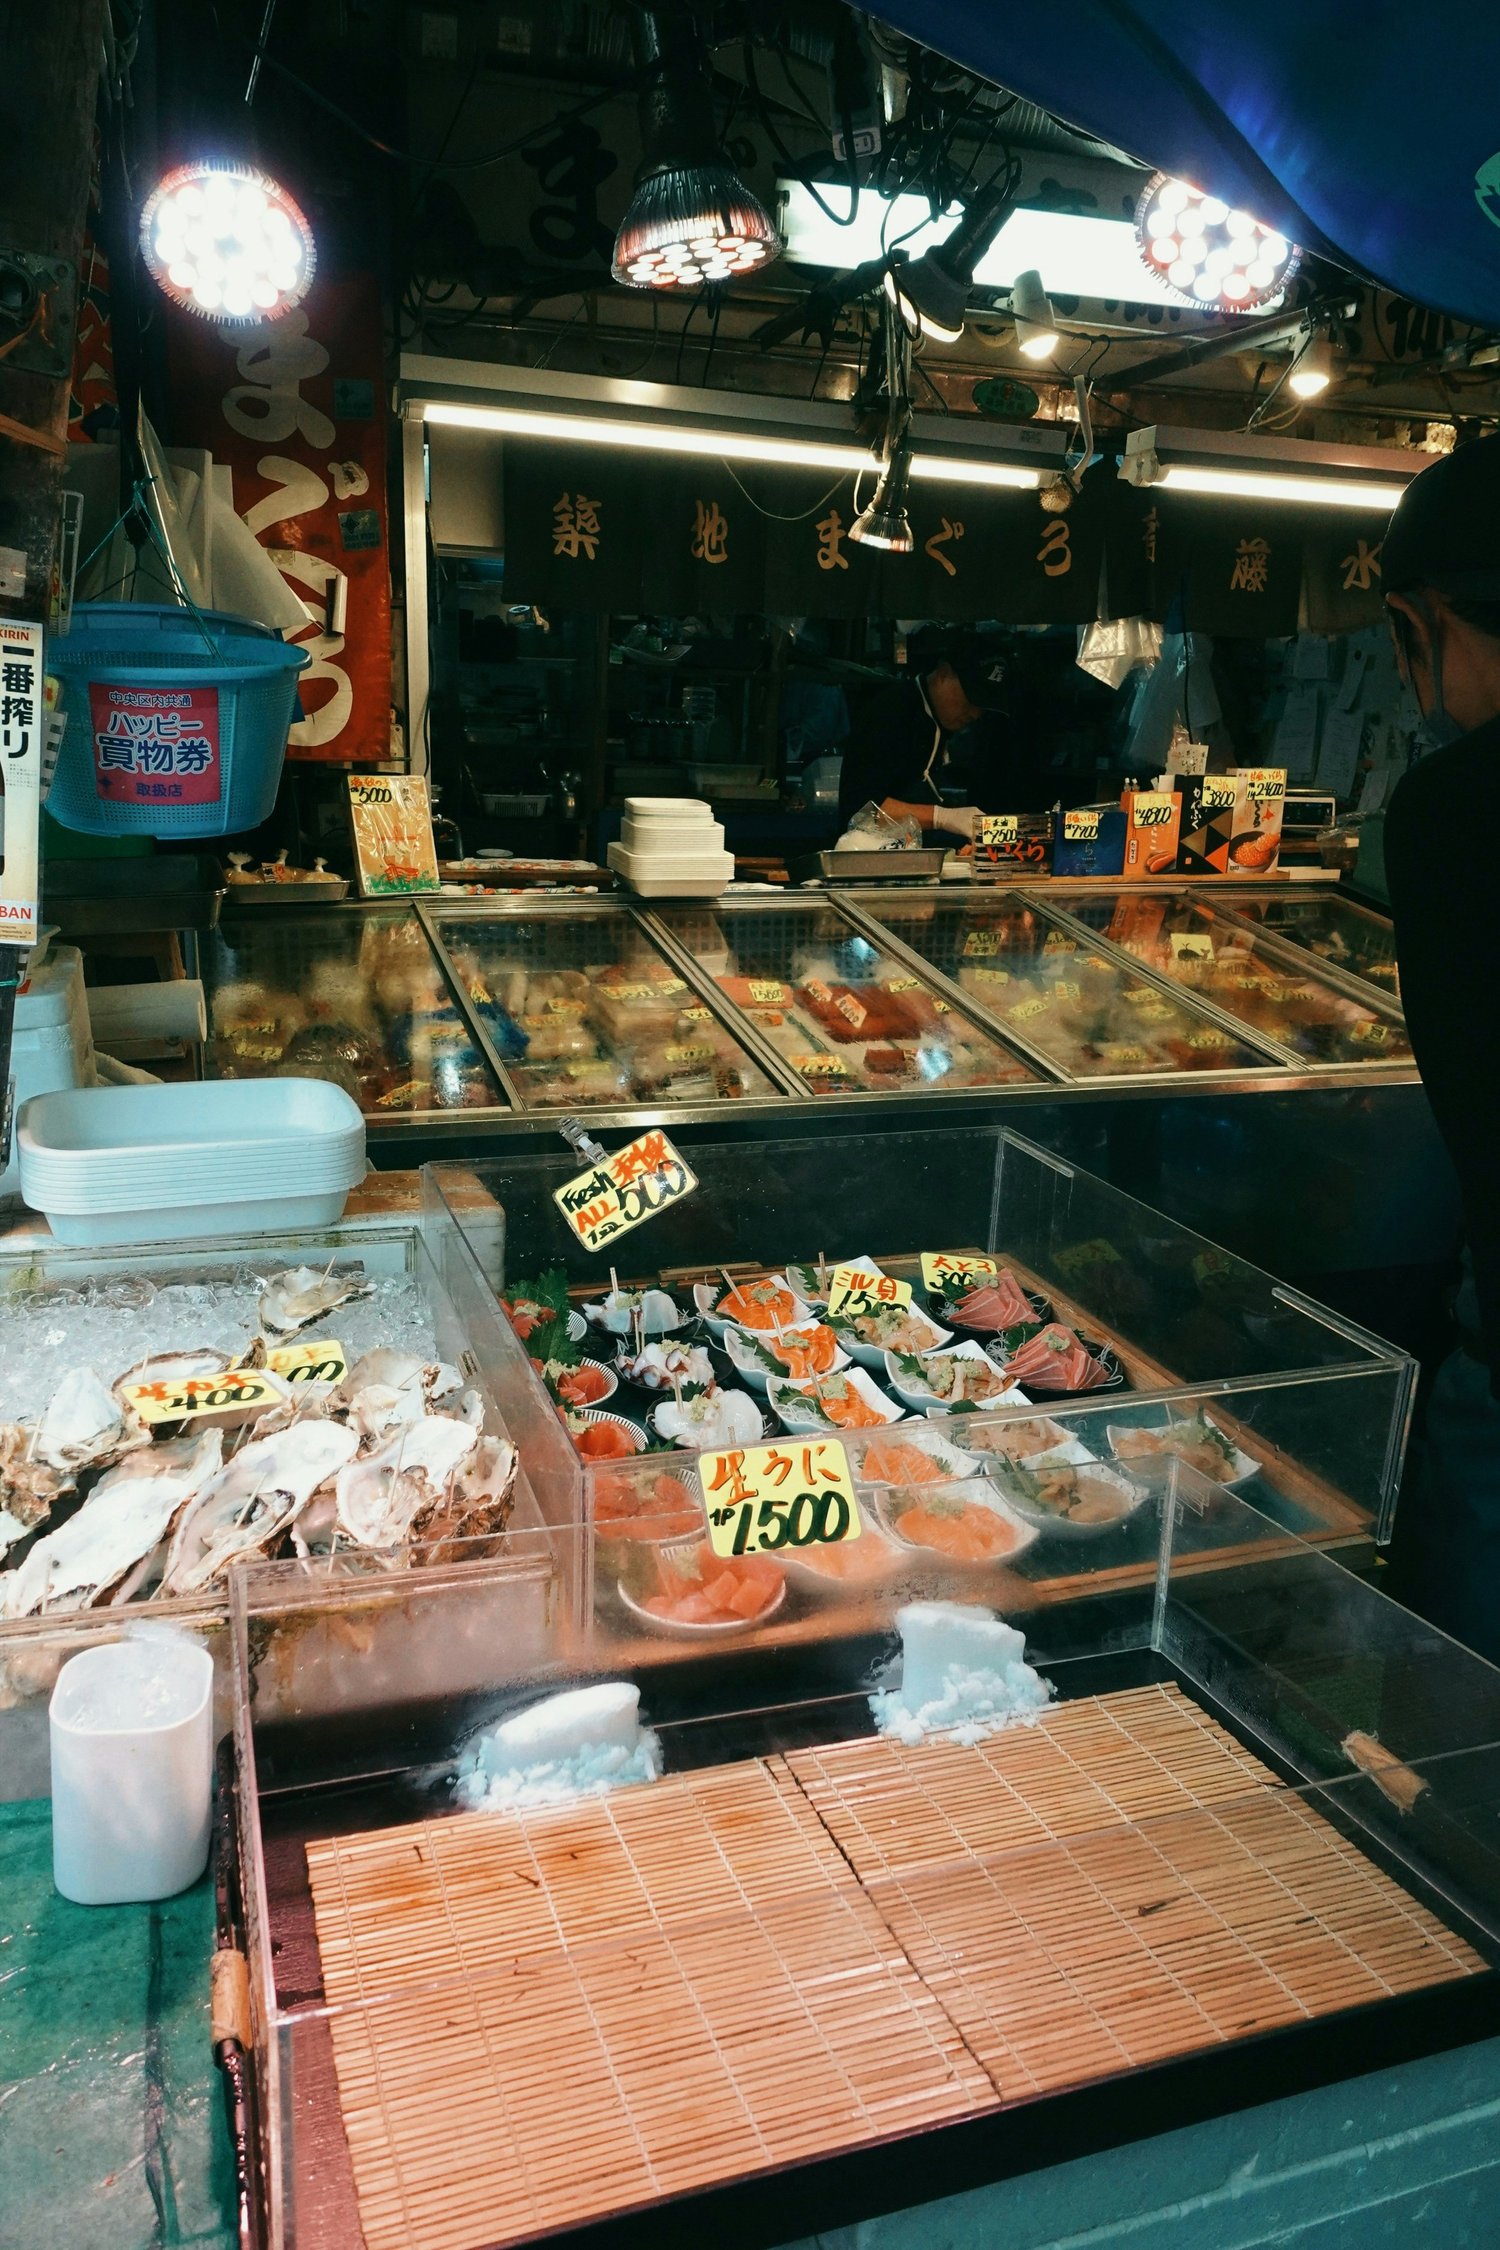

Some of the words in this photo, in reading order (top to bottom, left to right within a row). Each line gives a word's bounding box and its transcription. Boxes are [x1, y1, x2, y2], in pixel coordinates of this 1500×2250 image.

[553, 491, 1073, 577] 築地まぐろ
[2, 645, 35, 759] 一番搾り
[109, 691, 192, 708] 中央区内共通
[107, 711, 203, 738] ハッピー
[97, 734, 213, 775] 買物券
[135, 782, 183, 797] 取扱店
[359, 787, 392, 803] 5000
[1205, 789, 1236, 806] 3800
[1138, 806, 1171, 825] 4800
[987, 836, 1045, 863] いくら
[991, 829, 1017, 843] 7500
[561, 1170, 617, 1213] Fresh
[576, 1199, 618, 1233] ALL
[615, 1160, 688, 1221] 500
[932, 1256, 992, 1273] 大とろ
[708, 1445, 841, 1506] 生うに
